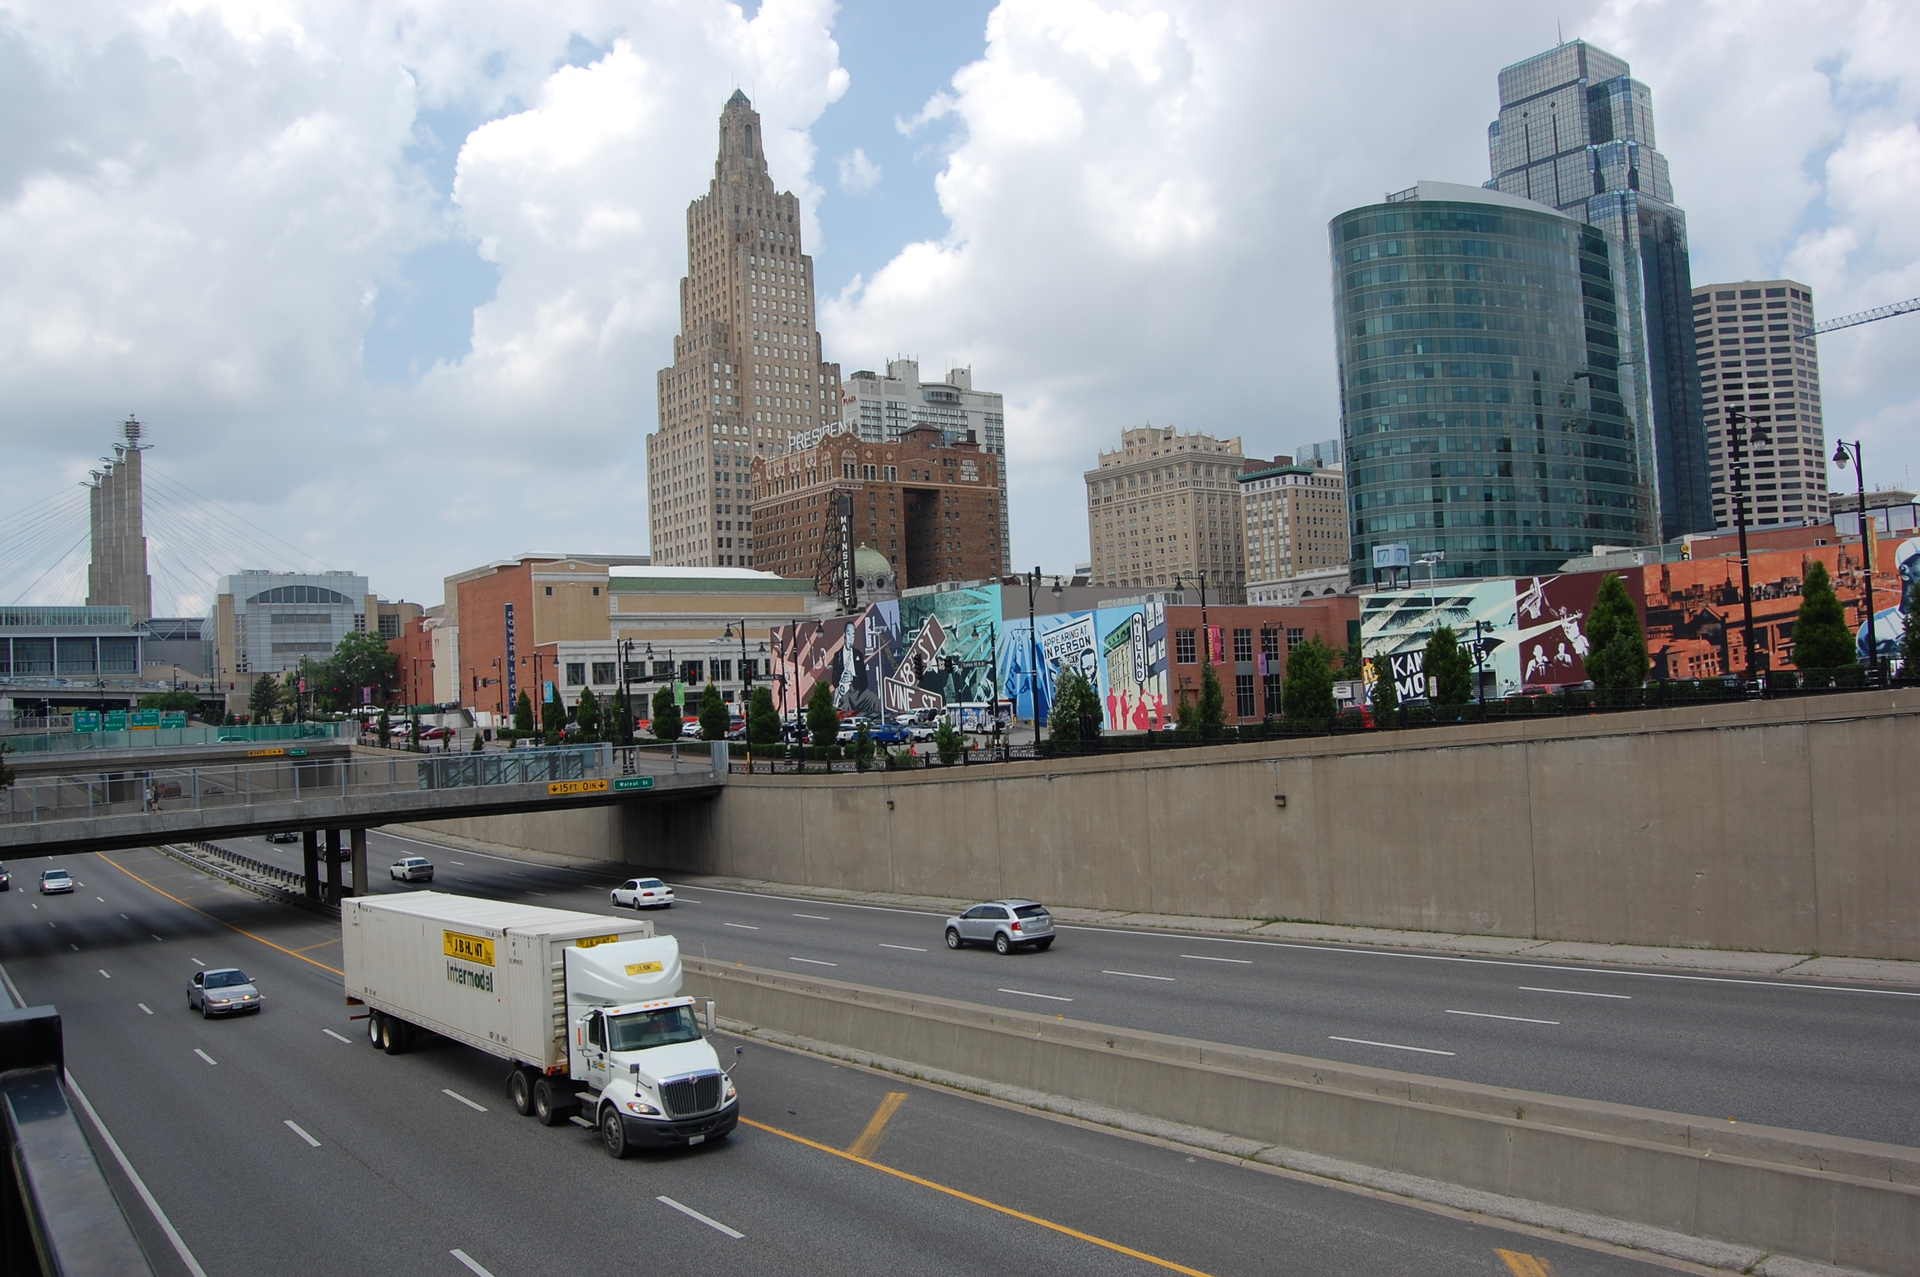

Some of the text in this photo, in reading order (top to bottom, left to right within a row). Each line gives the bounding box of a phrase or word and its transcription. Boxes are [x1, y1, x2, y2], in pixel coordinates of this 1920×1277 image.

[788, 417, 854, 453] PRESIDENT
[918, 624, 937, 664] ST
[1044, 625, 1087, 648] APPEARING AT
[1044, 647, 1053, 659] IN
[1054, 635, 1091, 657] PERSON
[1134, 618, 1143, 679] MIDLAND
[888, 682, 937, 711] VINE ST
[465, 940, 483, 957] HUNT
[446, 960, 493, 993] Intermodal
